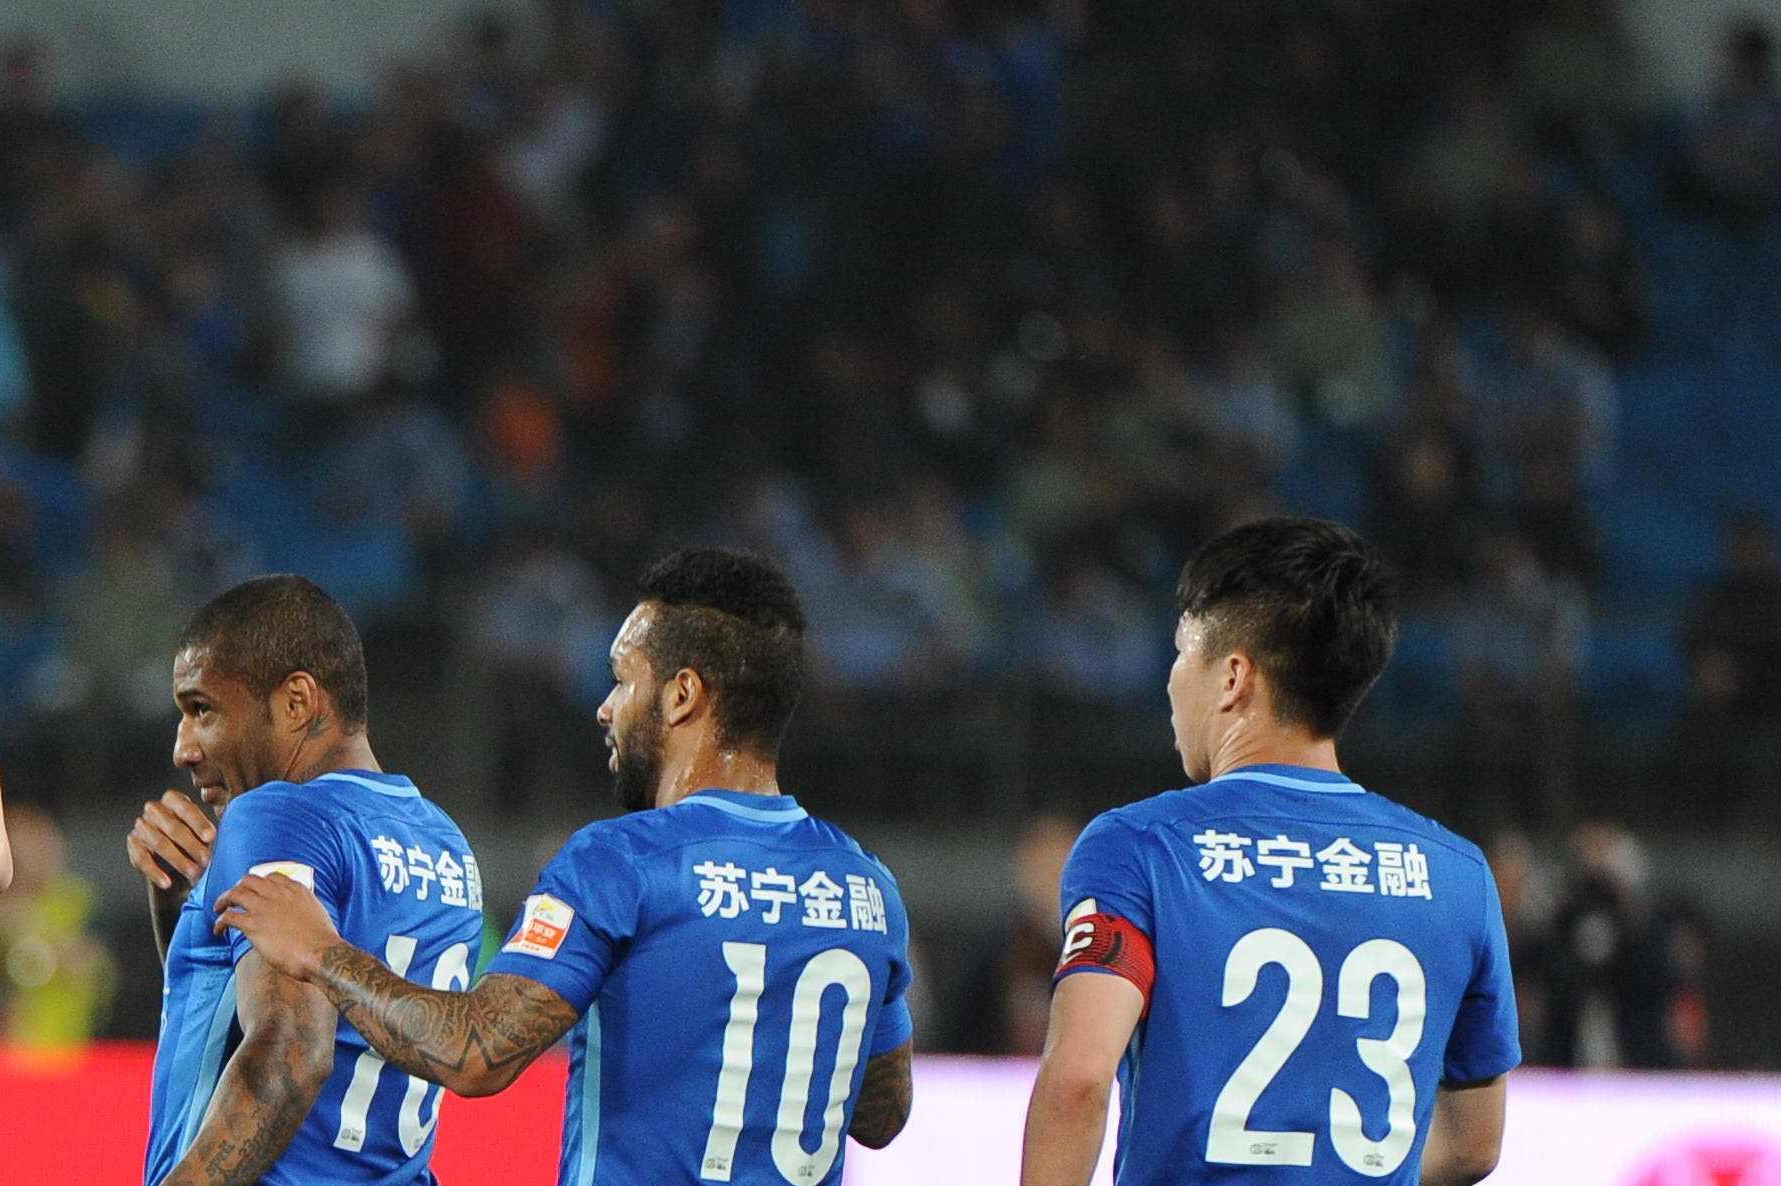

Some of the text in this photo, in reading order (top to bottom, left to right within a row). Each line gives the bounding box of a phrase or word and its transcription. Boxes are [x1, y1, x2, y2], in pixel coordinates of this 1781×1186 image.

[694, 860, 887, 935] 苏宁金融
[1194, 830, 1432, 901] 苏宁金融
[1205, 927, 1427, 1178] 23
